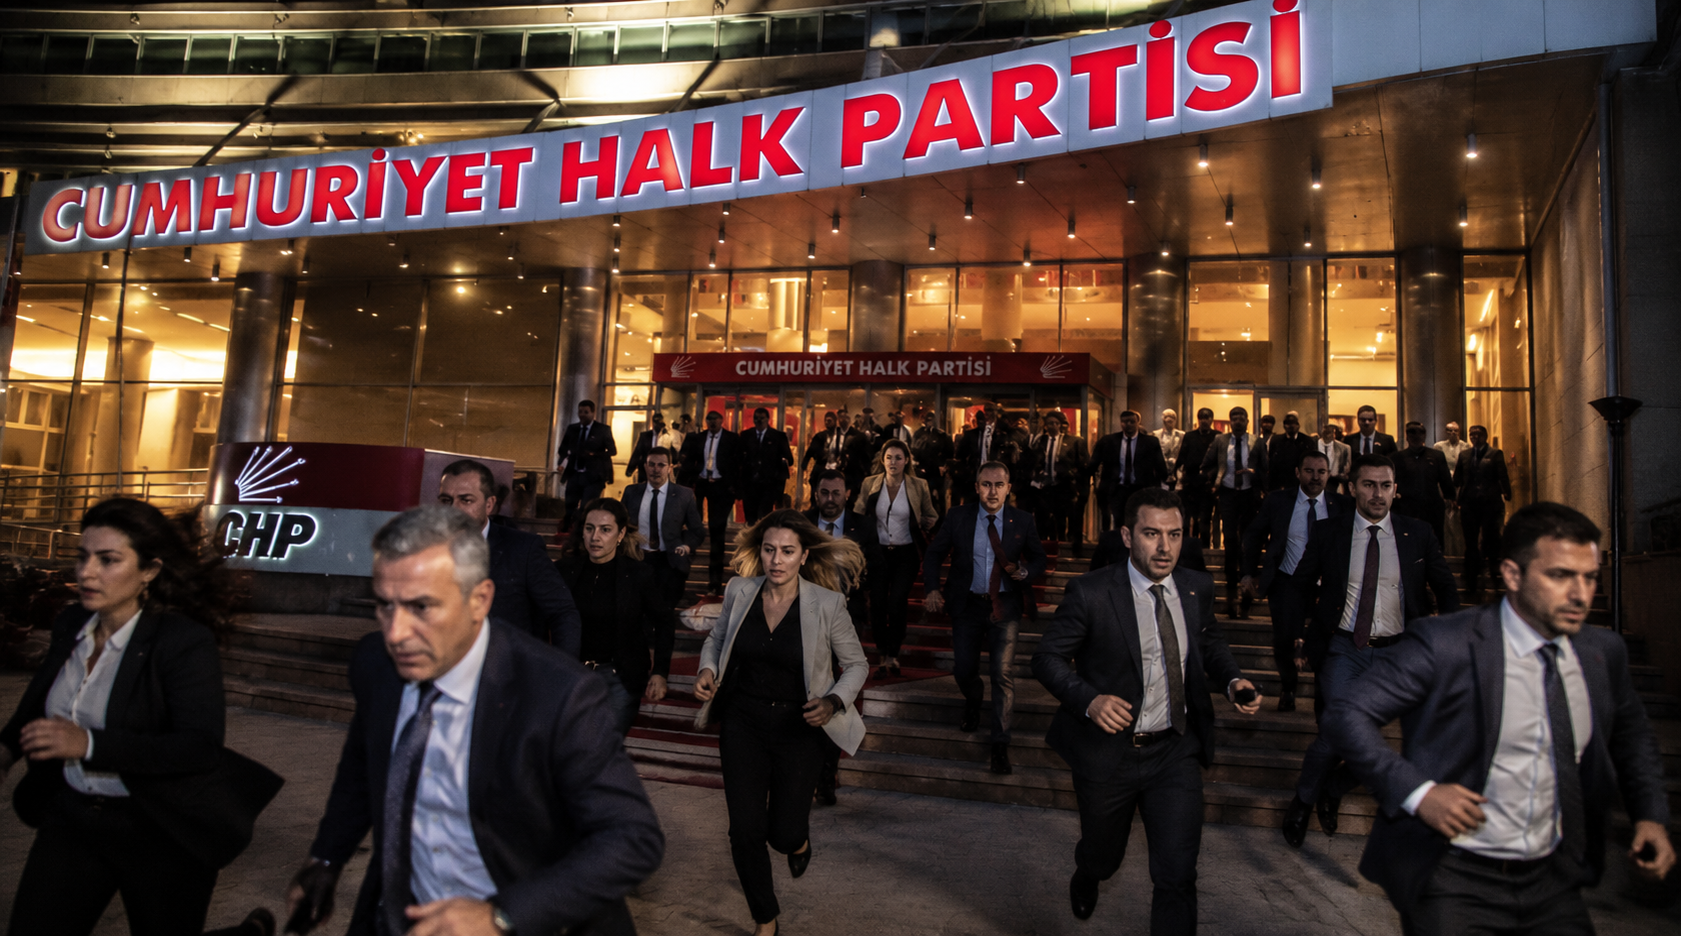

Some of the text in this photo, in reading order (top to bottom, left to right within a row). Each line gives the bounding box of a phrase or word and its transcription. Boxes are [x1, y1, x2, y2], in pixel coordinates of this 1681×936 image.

[42, 0, 1302, 243] CUMHURİYET HALK PARTİSİ
[735, 356, 991, 377] CUMHURİYET HALK PARTİSİ
[213, 509, 318, 560] CHP
